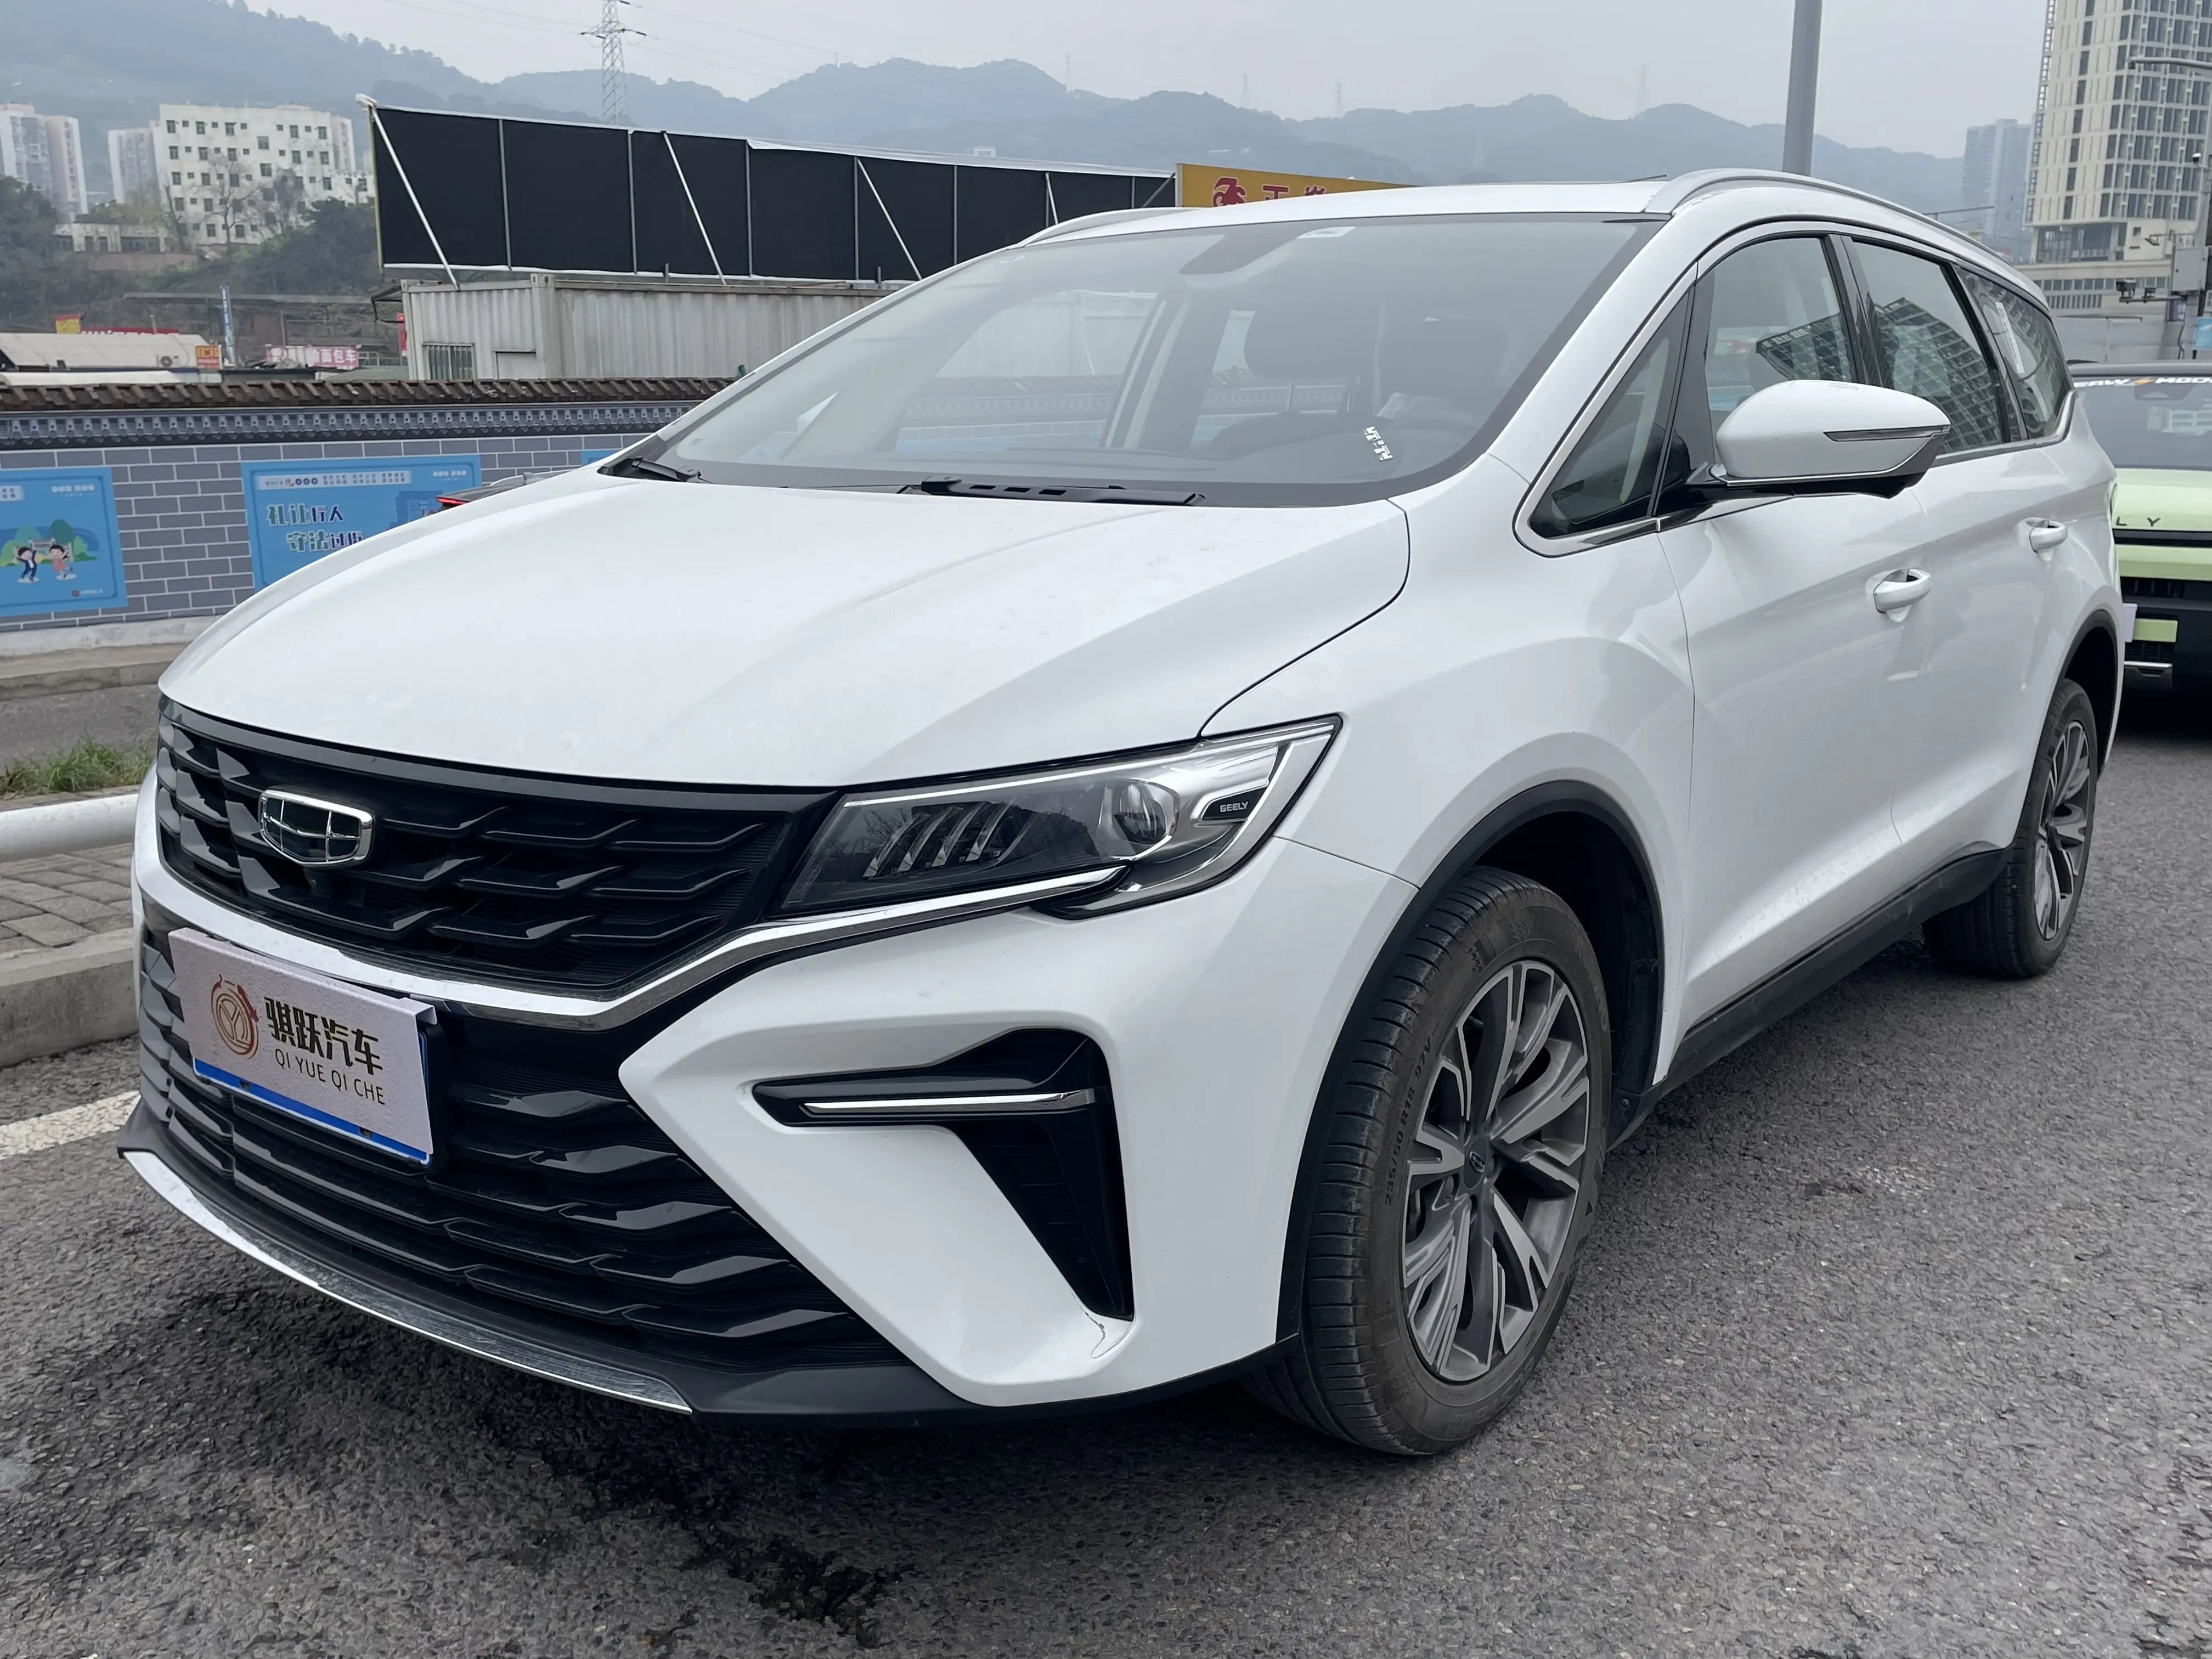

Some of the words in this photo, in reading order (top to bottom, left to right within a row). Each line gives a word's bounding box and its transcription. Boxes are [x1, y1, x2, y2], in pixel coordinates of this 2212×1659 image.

[267, 503, 345, 526] 礼让行人
[1220, 802, 1249, 812] GEELY
[264, 996, 383, 1075] 骐跃汽车
[275, 1048, 291, 1069] QI
[295, 1055, 326, 1082] YUE
[331, 1070, 347, 1092] QI
[354, 1079, 385, 1105] CHE
